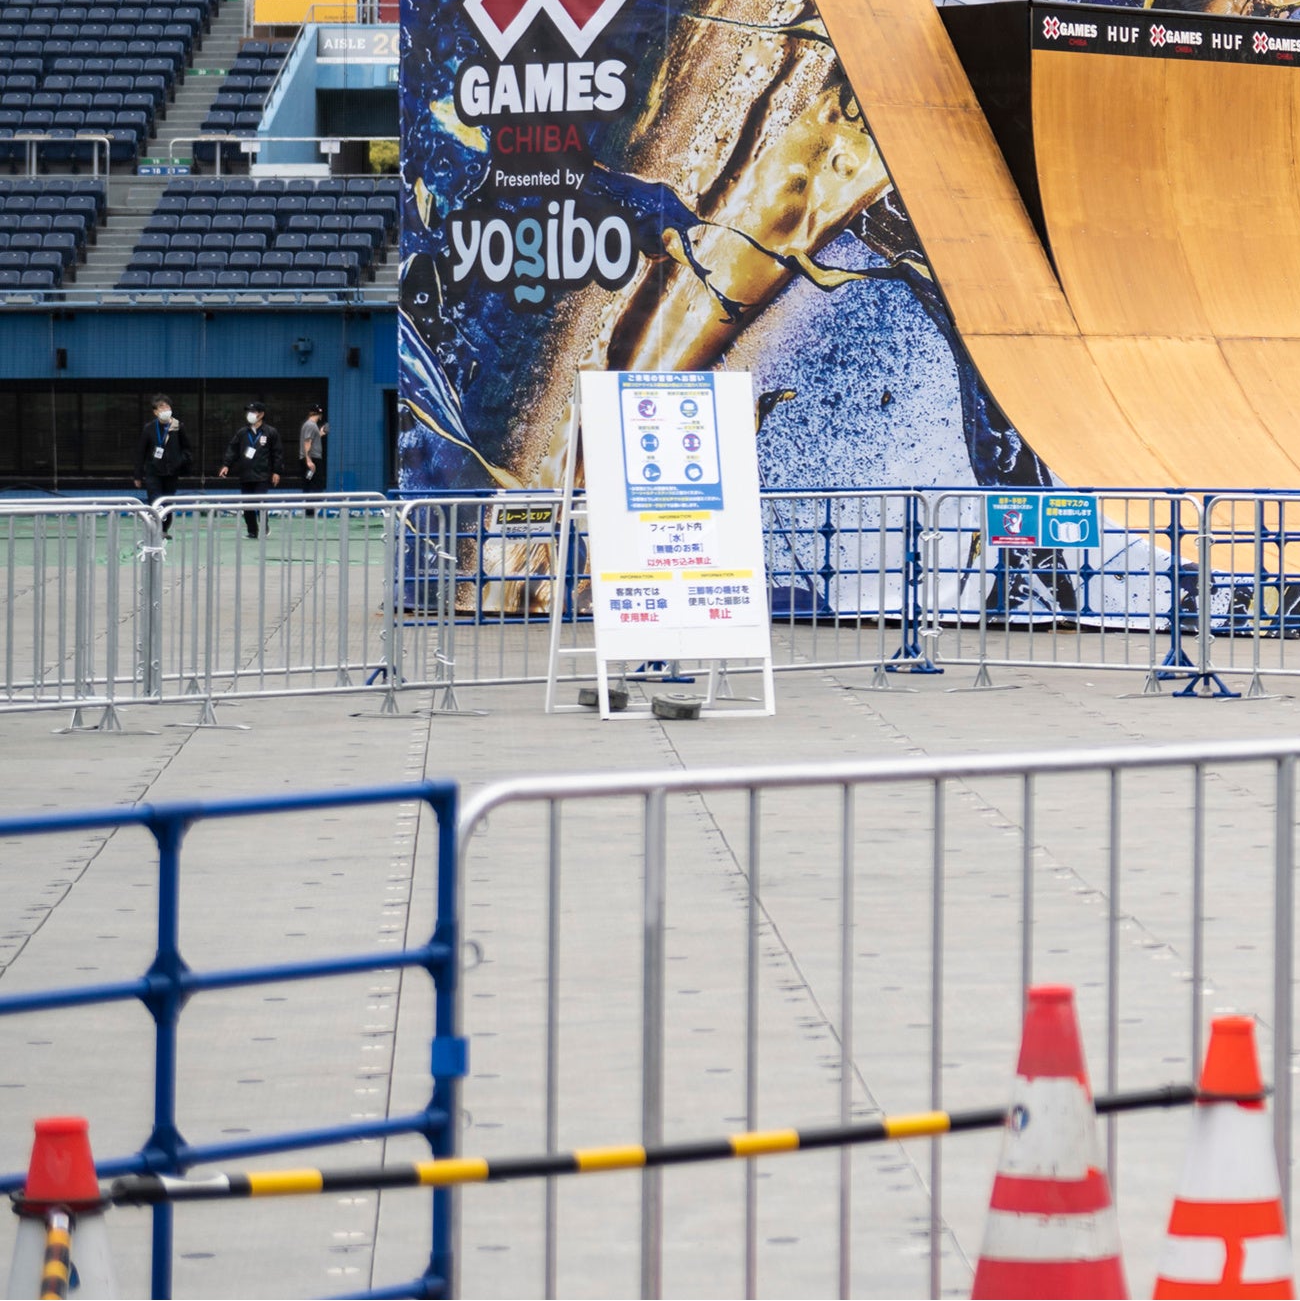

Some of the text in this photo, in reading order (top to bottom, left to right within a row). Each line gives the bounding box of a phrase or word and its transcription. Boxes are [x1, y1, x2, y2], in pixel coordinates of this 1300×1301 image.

[324, 38, 366, 50] AISLE
[1060, 22, 1098, 38] GAMES
[1108, 25, 1139, 43] HUF
[1166, 29, 1202, 46] GAMES
[1212, 32, 1243, 50] HUF
[460, 59, 627, 117] GAMES
[496, 123, 583, 155] CHIBA
[496, 169, 585, 189] Presented by
[452, 199, 632, 303] yogibo
[650, 522, 703, 532] フィールド内
[609, 599, 669, 611] 雨傘・日傘
[619, 612, 660, 623] 使用禁止
[709, 608, 733, 620] 禁止
